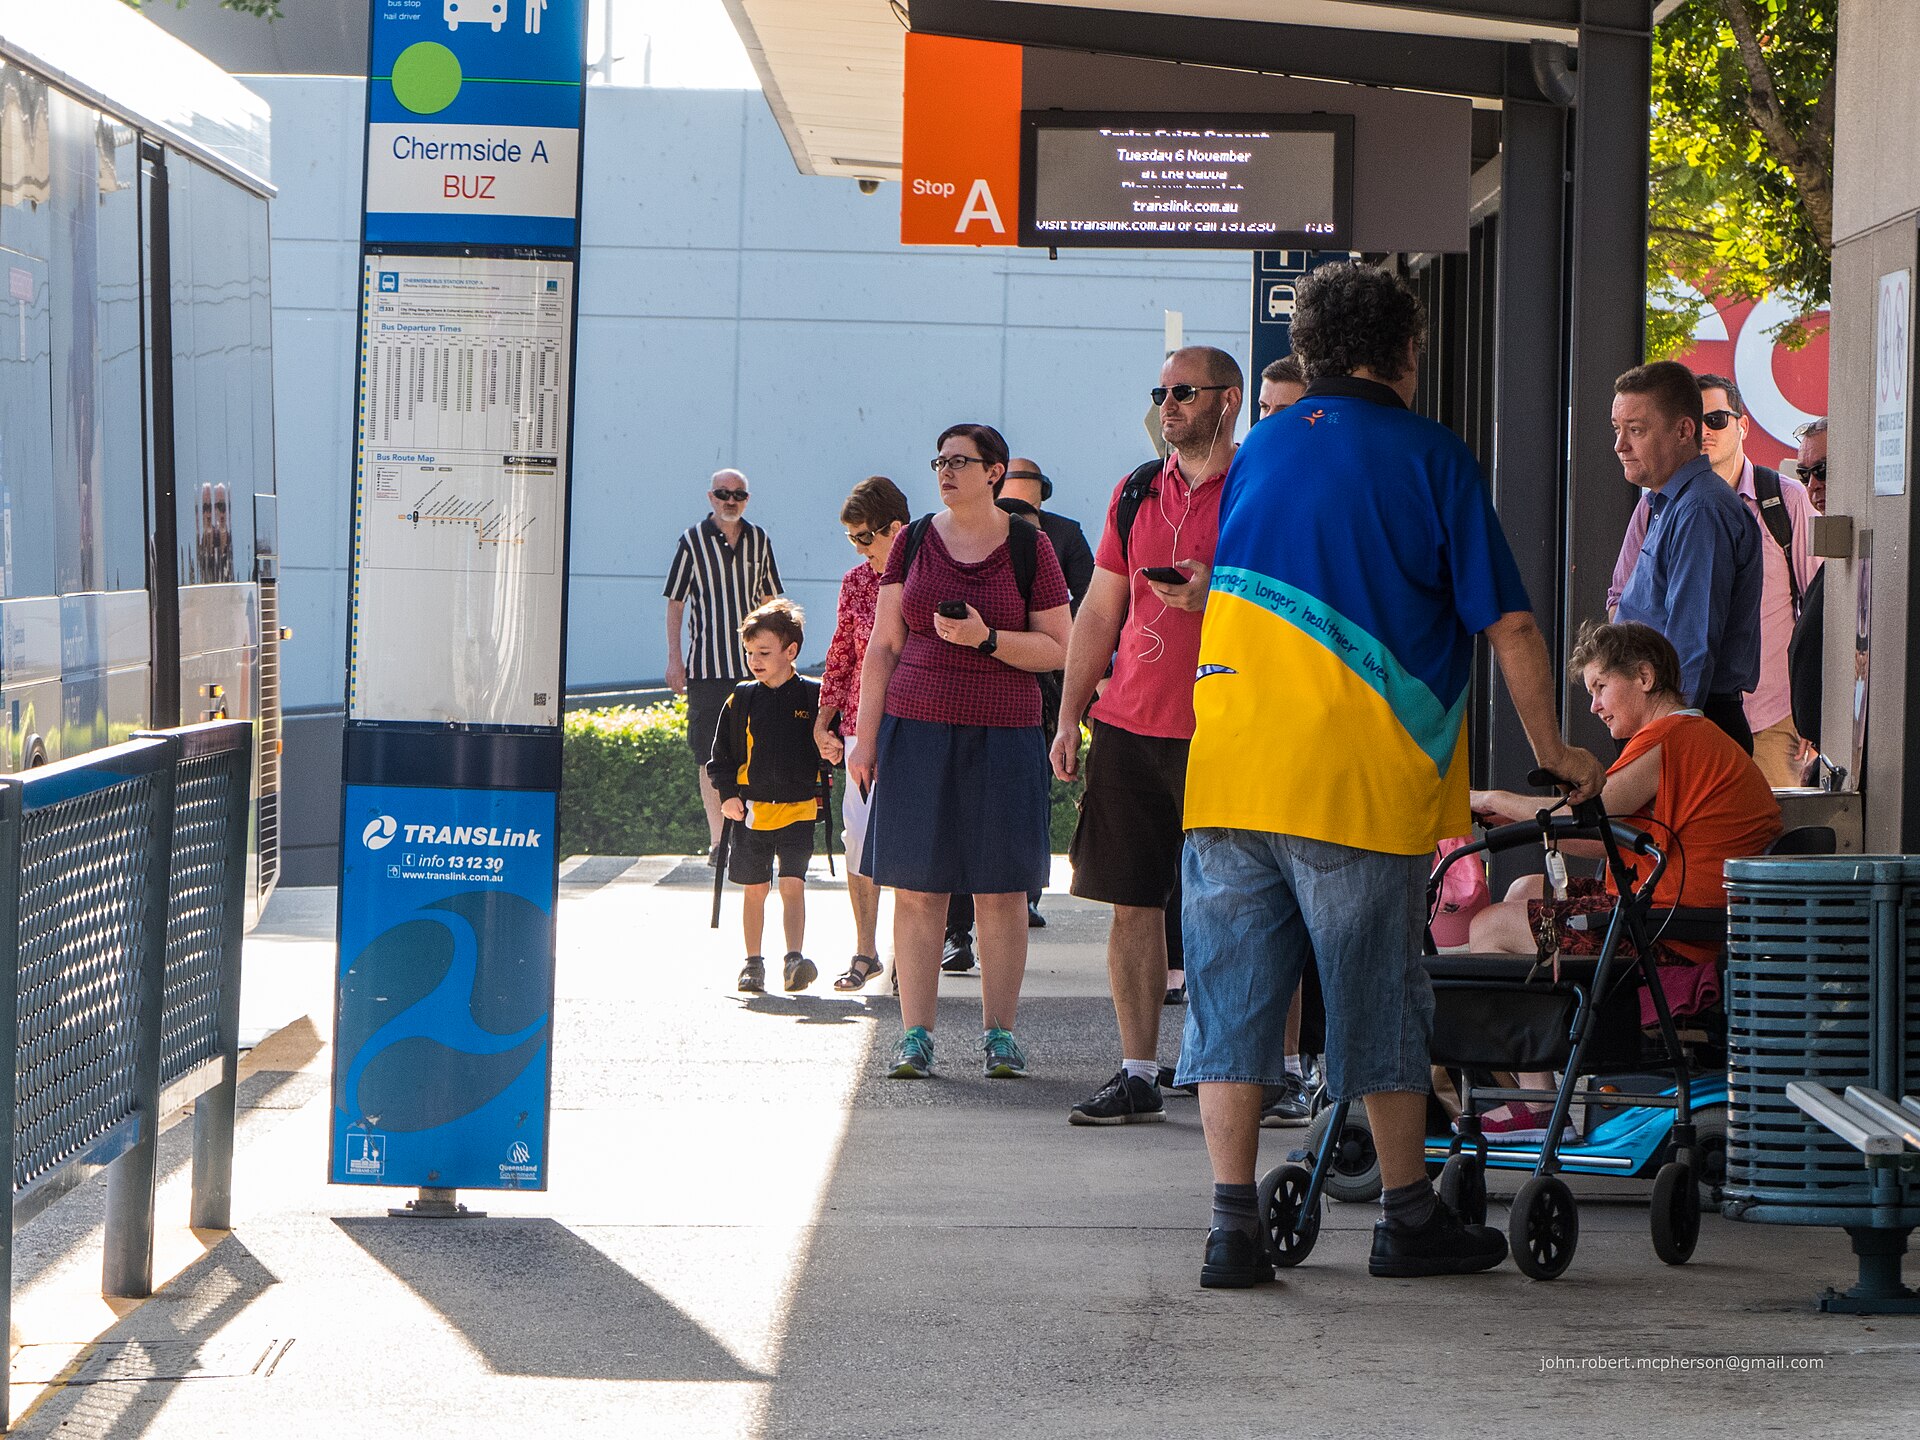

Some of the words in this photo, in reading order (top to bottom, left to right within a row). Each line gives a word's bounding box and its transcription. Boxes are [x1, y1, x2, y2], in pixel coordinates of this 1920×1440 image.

[404, 0, 421, 8] stop
[393, 135, 521, 163] Chermside
[531, 140, 549, 163] A
[1117, 148, 1172, 162] Tuesday
[1175, 149, 1184, 161] 6
[1187, 149, 1252, 162] November
[444, 174, 496, 199] BUZ
[912, 179, 955, 198] Stop
[954, 179, 1006, 233] A
[1132, 200, 1239, 213] translink.com.au
[1177, 221, 1192, 231] or
[1194, 221, 1217, 232] call
[397, 324, 436, 332] Departure
[418, 455, 435, 463] Map
[1255, 581, 1297, 614] longer,
[1301, 605, 1359, 654] healthier
[1362, 652, 1390, 684] lives
[404, 825, 542, 848] TRANSLink
[418, 854, 445, 868] info
[448, 856, 464, 868] 13
[466, 857, 482, 869] 12
[484, 857, 504, 870] 30
[402, 871, 504, 882] www.translink.com.au
[499, 1164, 538, 1172] Queensland
